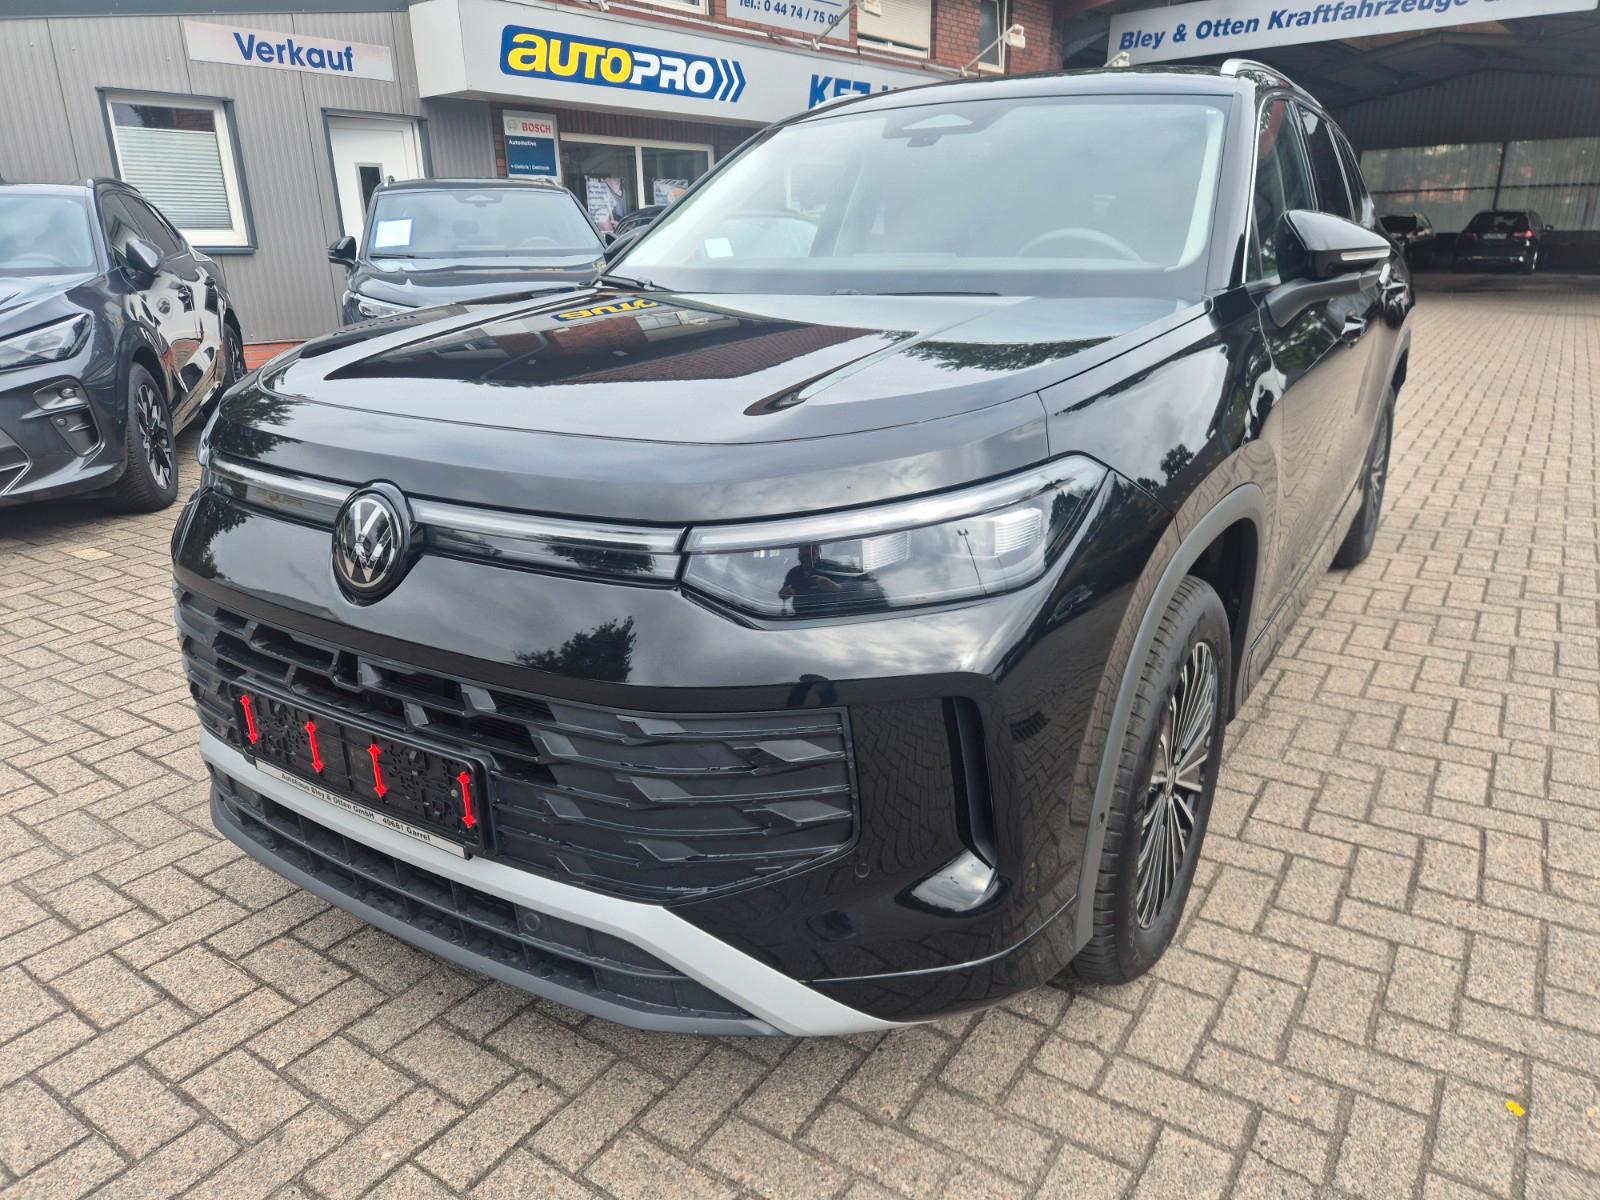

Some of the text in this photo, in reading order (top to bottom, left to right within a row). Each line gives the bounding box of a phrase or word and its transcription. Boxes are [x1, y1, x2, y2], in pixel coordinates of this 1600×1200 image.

[764, 0, 771, 12] 0
[774, 2, 787, 16] 44
[790, 5, 803, 19] 74
[805, 8, 811, 21] /
[813, 10, 826, 24] 75
[1119, 30, 1165, 50] Bley
[1172, 24, 1187, 43] &
[1195, 17, 1259, 40] Otten
[233, 32, 353, 72] Verkauf
[521, 122, 552, 134] BOSCH
[353, 805, 375, 819] GmbH
[406, 827, 431, 841] Garrel
